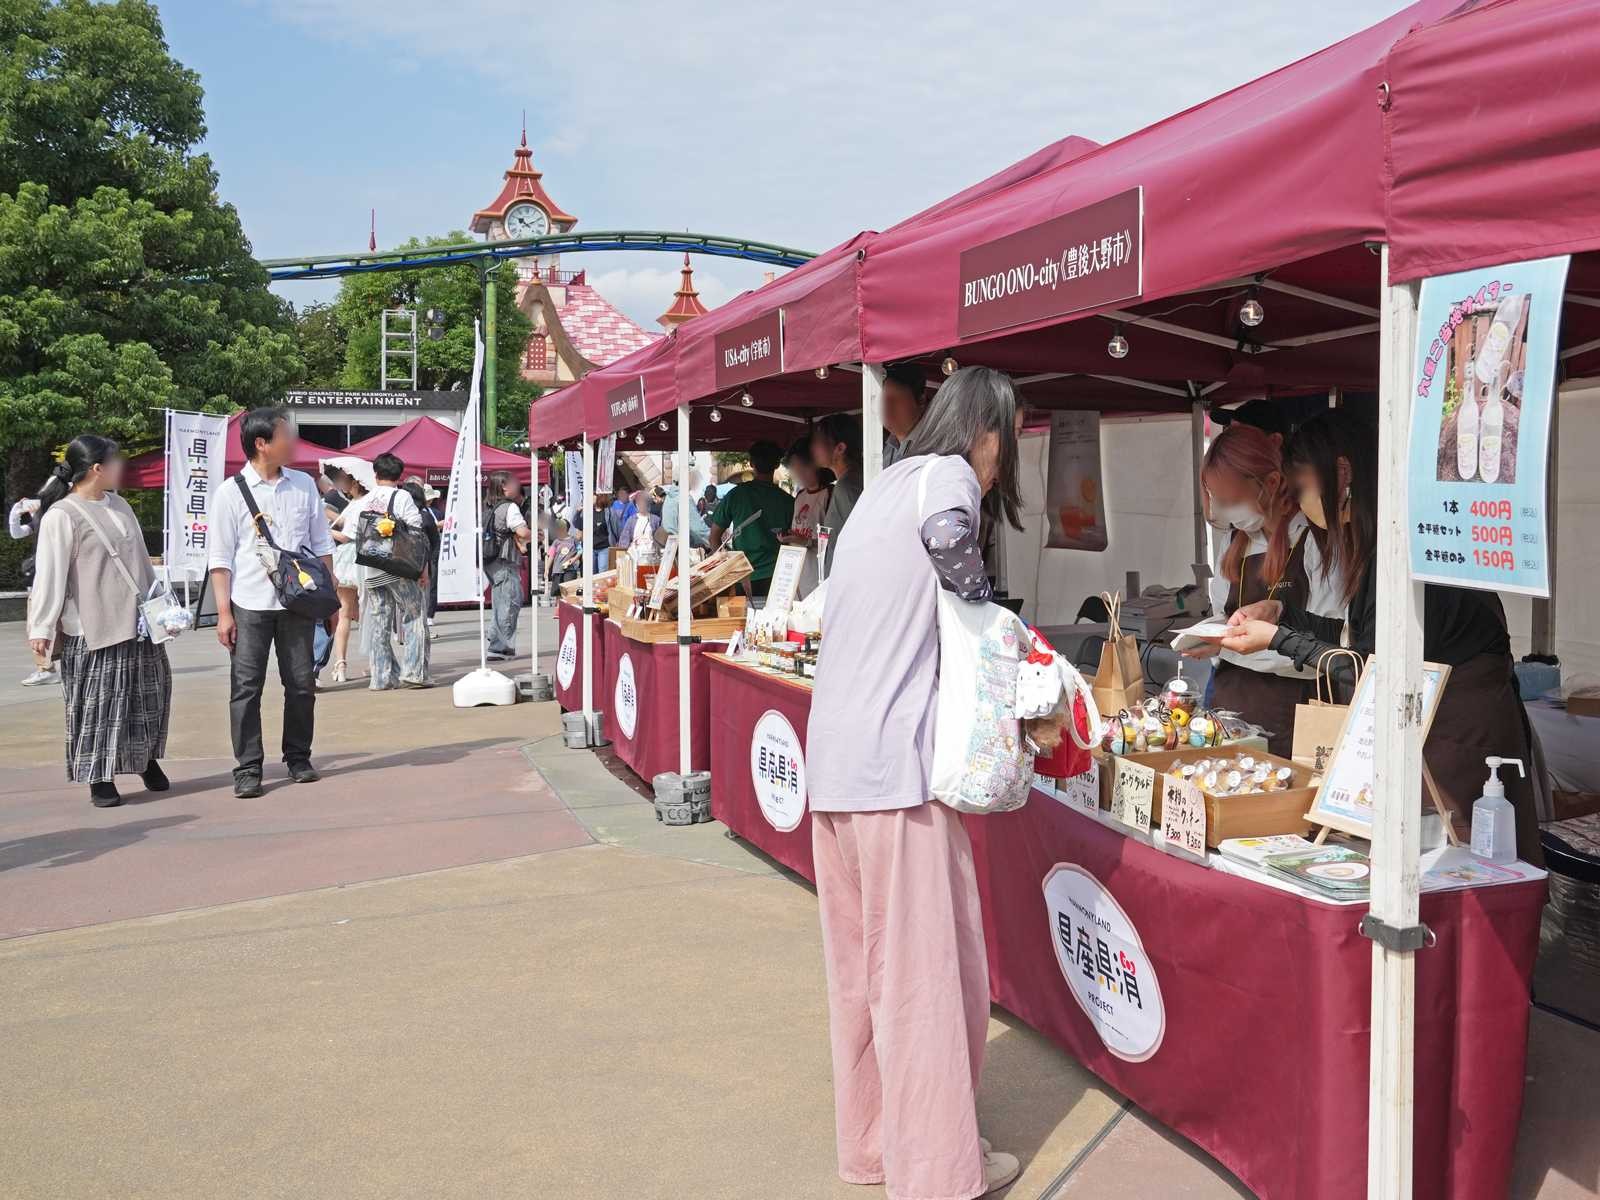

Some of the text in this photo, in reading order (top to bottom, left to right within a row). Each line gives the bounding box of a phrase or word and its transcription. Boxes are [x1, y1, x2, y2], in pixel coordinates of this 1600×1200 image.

[308, 396, 422, 406] ENTERTAINMENT
[1442, 500, 1460, 515] 1本
[1470, 500, 1512, 520] 400円
[1471, 525, 1513, 546] 500円
[1473, 549, 1515, 571] 150円
